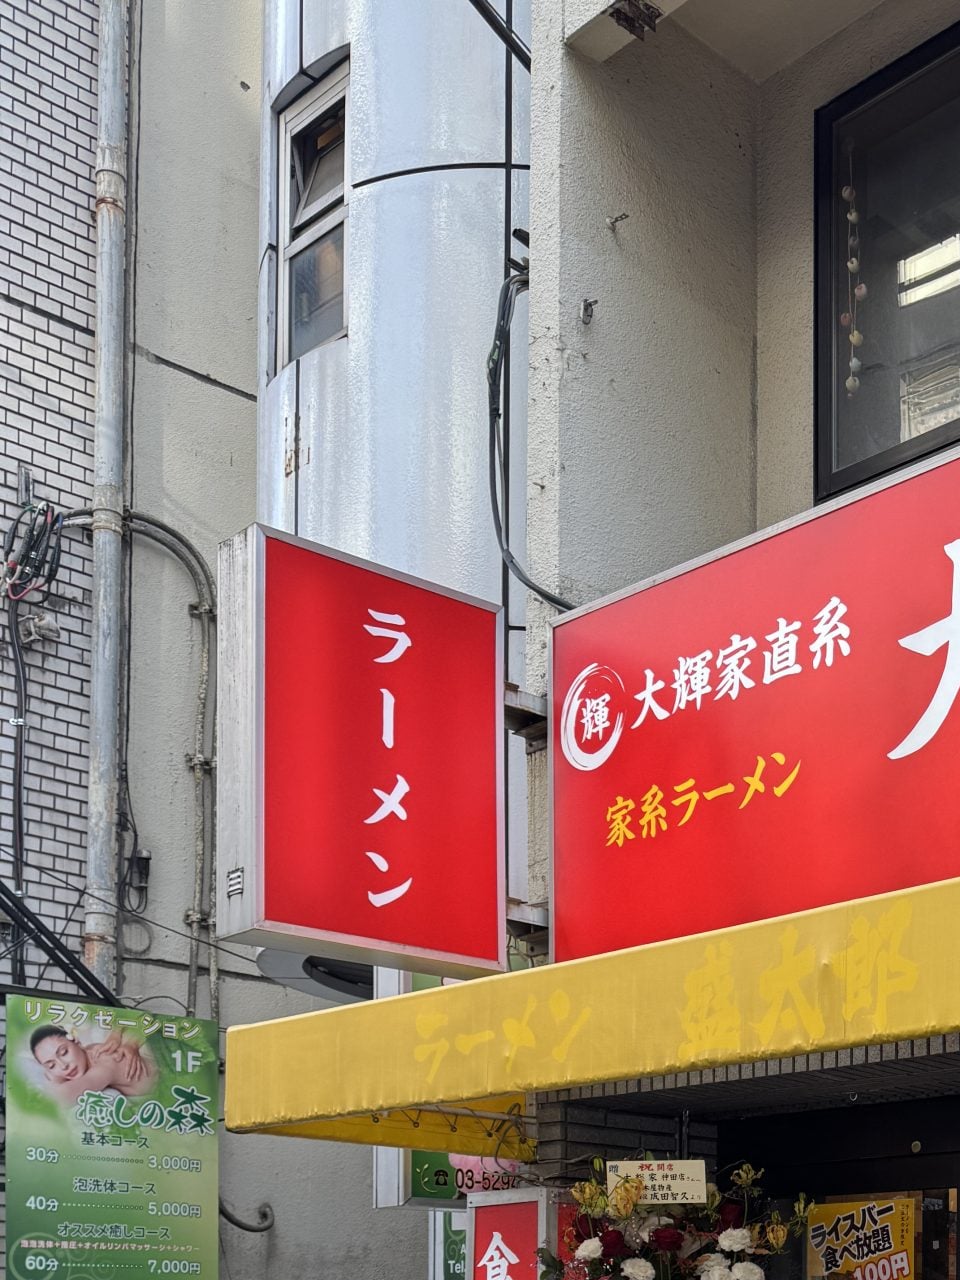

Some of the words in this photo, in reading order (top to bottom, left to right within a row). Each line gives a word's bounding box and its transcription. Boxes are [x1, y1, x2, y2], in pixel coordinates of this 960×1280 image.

[630, 596, 852, 729] 大輝家直系
[580, 692, 612, 744] 輝
[363, 608, 412, 908] ラーメン
[605, 751, 802, 848] 家系ラーメン
[24, 1000, 200, 1041] リラクゼーション
[171, 1050, 203, 1074] 1F
[76, 1084, 215, 1136] 癒しの森
[26, 1147, 59, 1164] 30分
[147, 1156, 201, 1173] 3,000円
[81, 1131, 150, 1149] 基本コース
[73, 1177, 156, 1195] 泡洗体コース
[26, 1196, 59, 1213] 40分
[147, 1202, 201, 1218] 5,000円
[809, 1202, 894, 1248] ライスバー
[57, 1221, 171, 1240] オススメ癒しコース
[821, 1223, 893, 1273] 食べ放題
[25, 1255, 59, 1272] 60分
[147, 1259, 201, 1275] 7,000円
